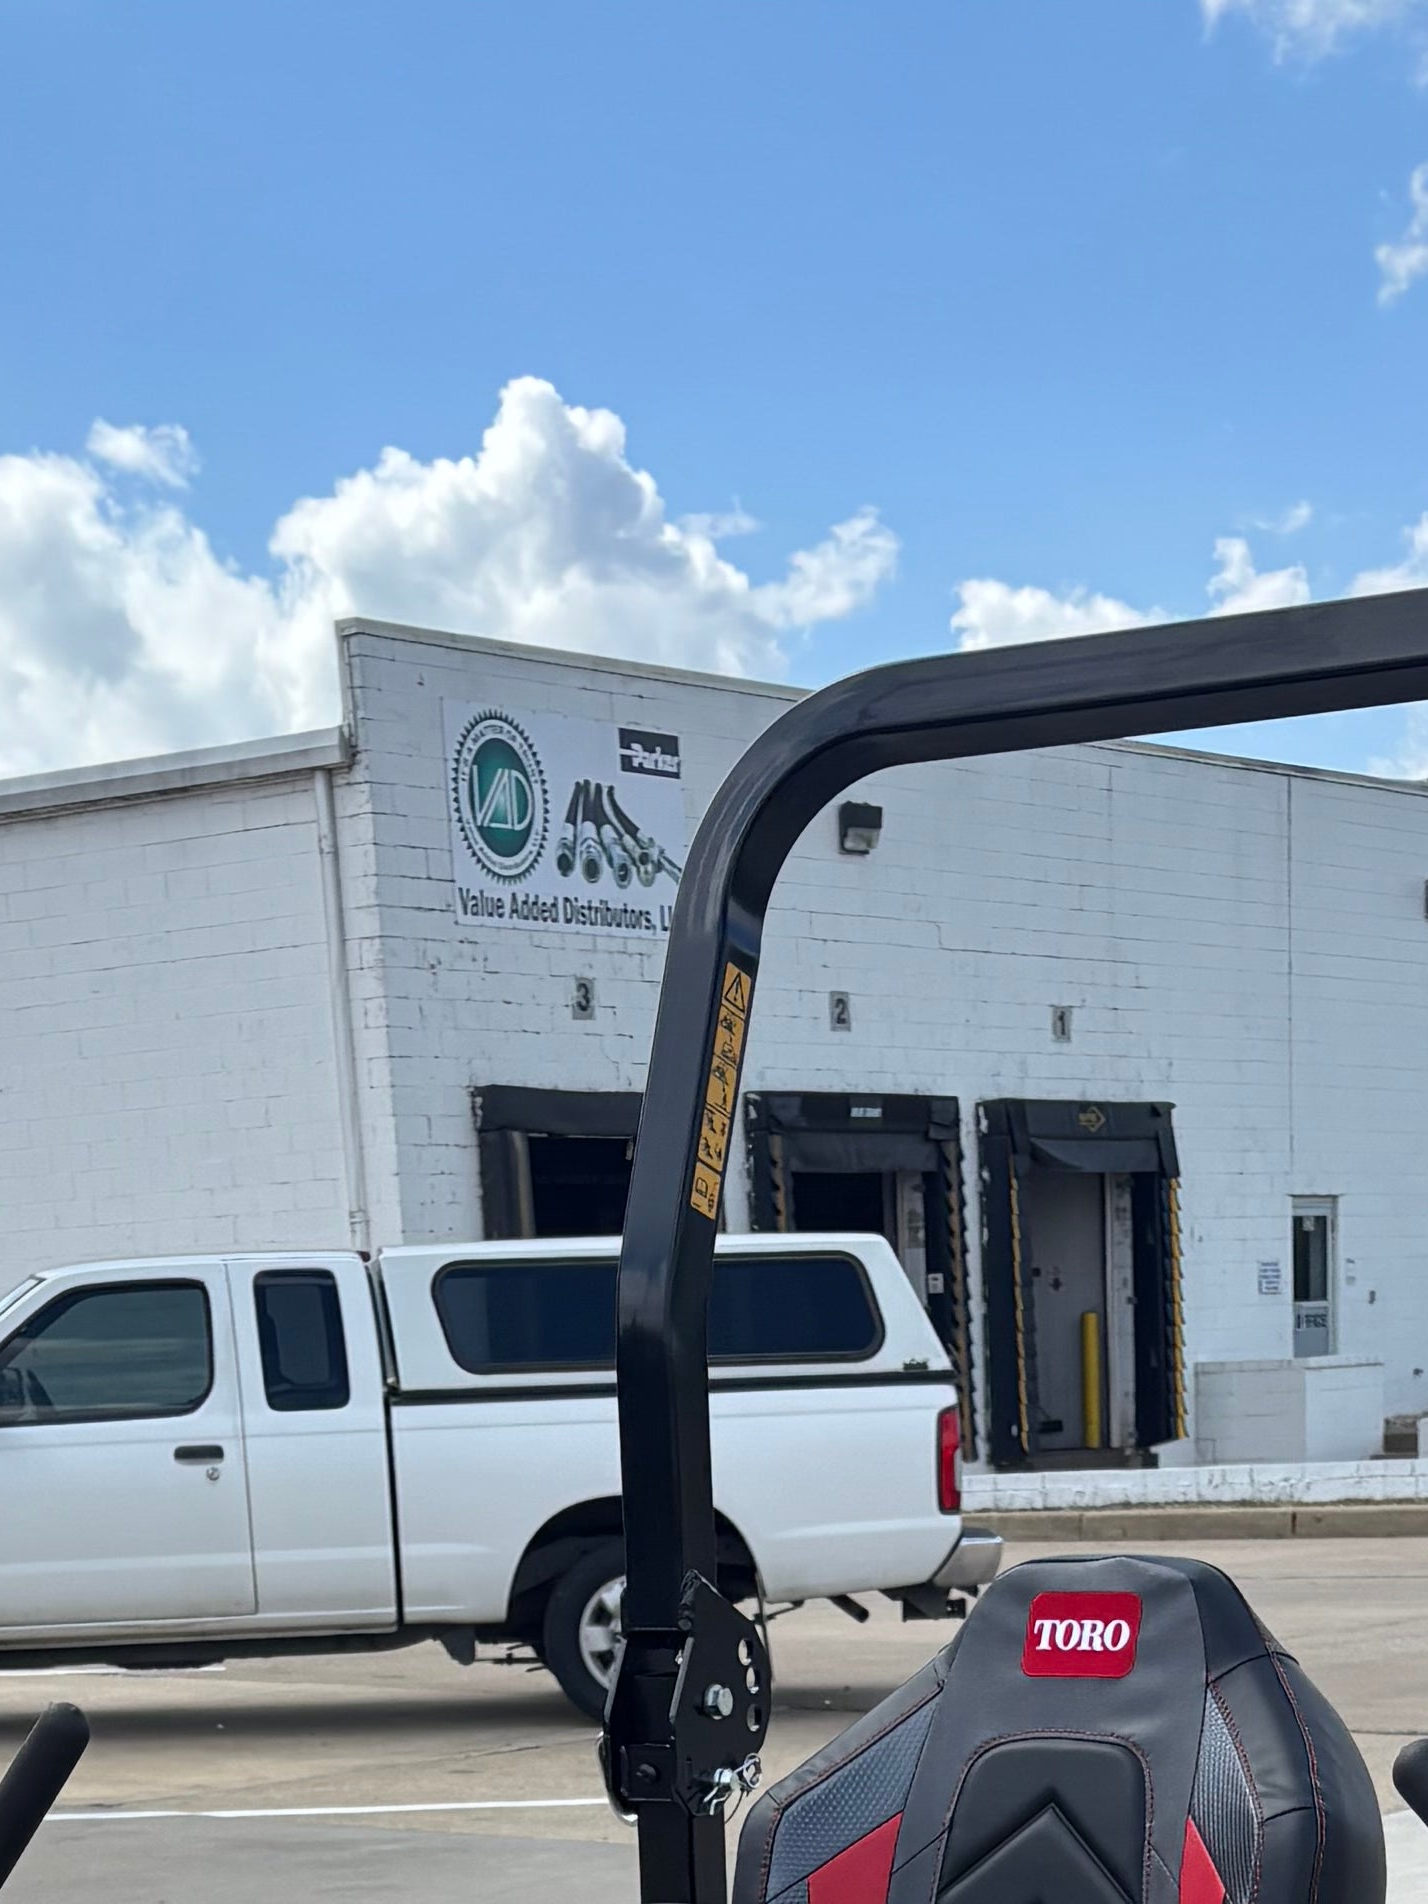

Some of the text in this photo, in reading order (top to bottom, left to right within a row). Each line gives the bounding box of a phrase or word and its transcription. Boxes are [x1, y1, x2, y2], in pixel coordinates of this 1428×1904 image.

[472, 765, 534, 831] VAD
[458, 887, 505, 918] Value
[509, 892, 559, 923] Added
[563, 897, 657, 935] Distributors,
[575, 982, 591, 1013] 3
[834, 998, 847, 1025] 2
[1058, 1010, 1066, 1036] 1
[1033, 1619, 1130, 1652] TORO
